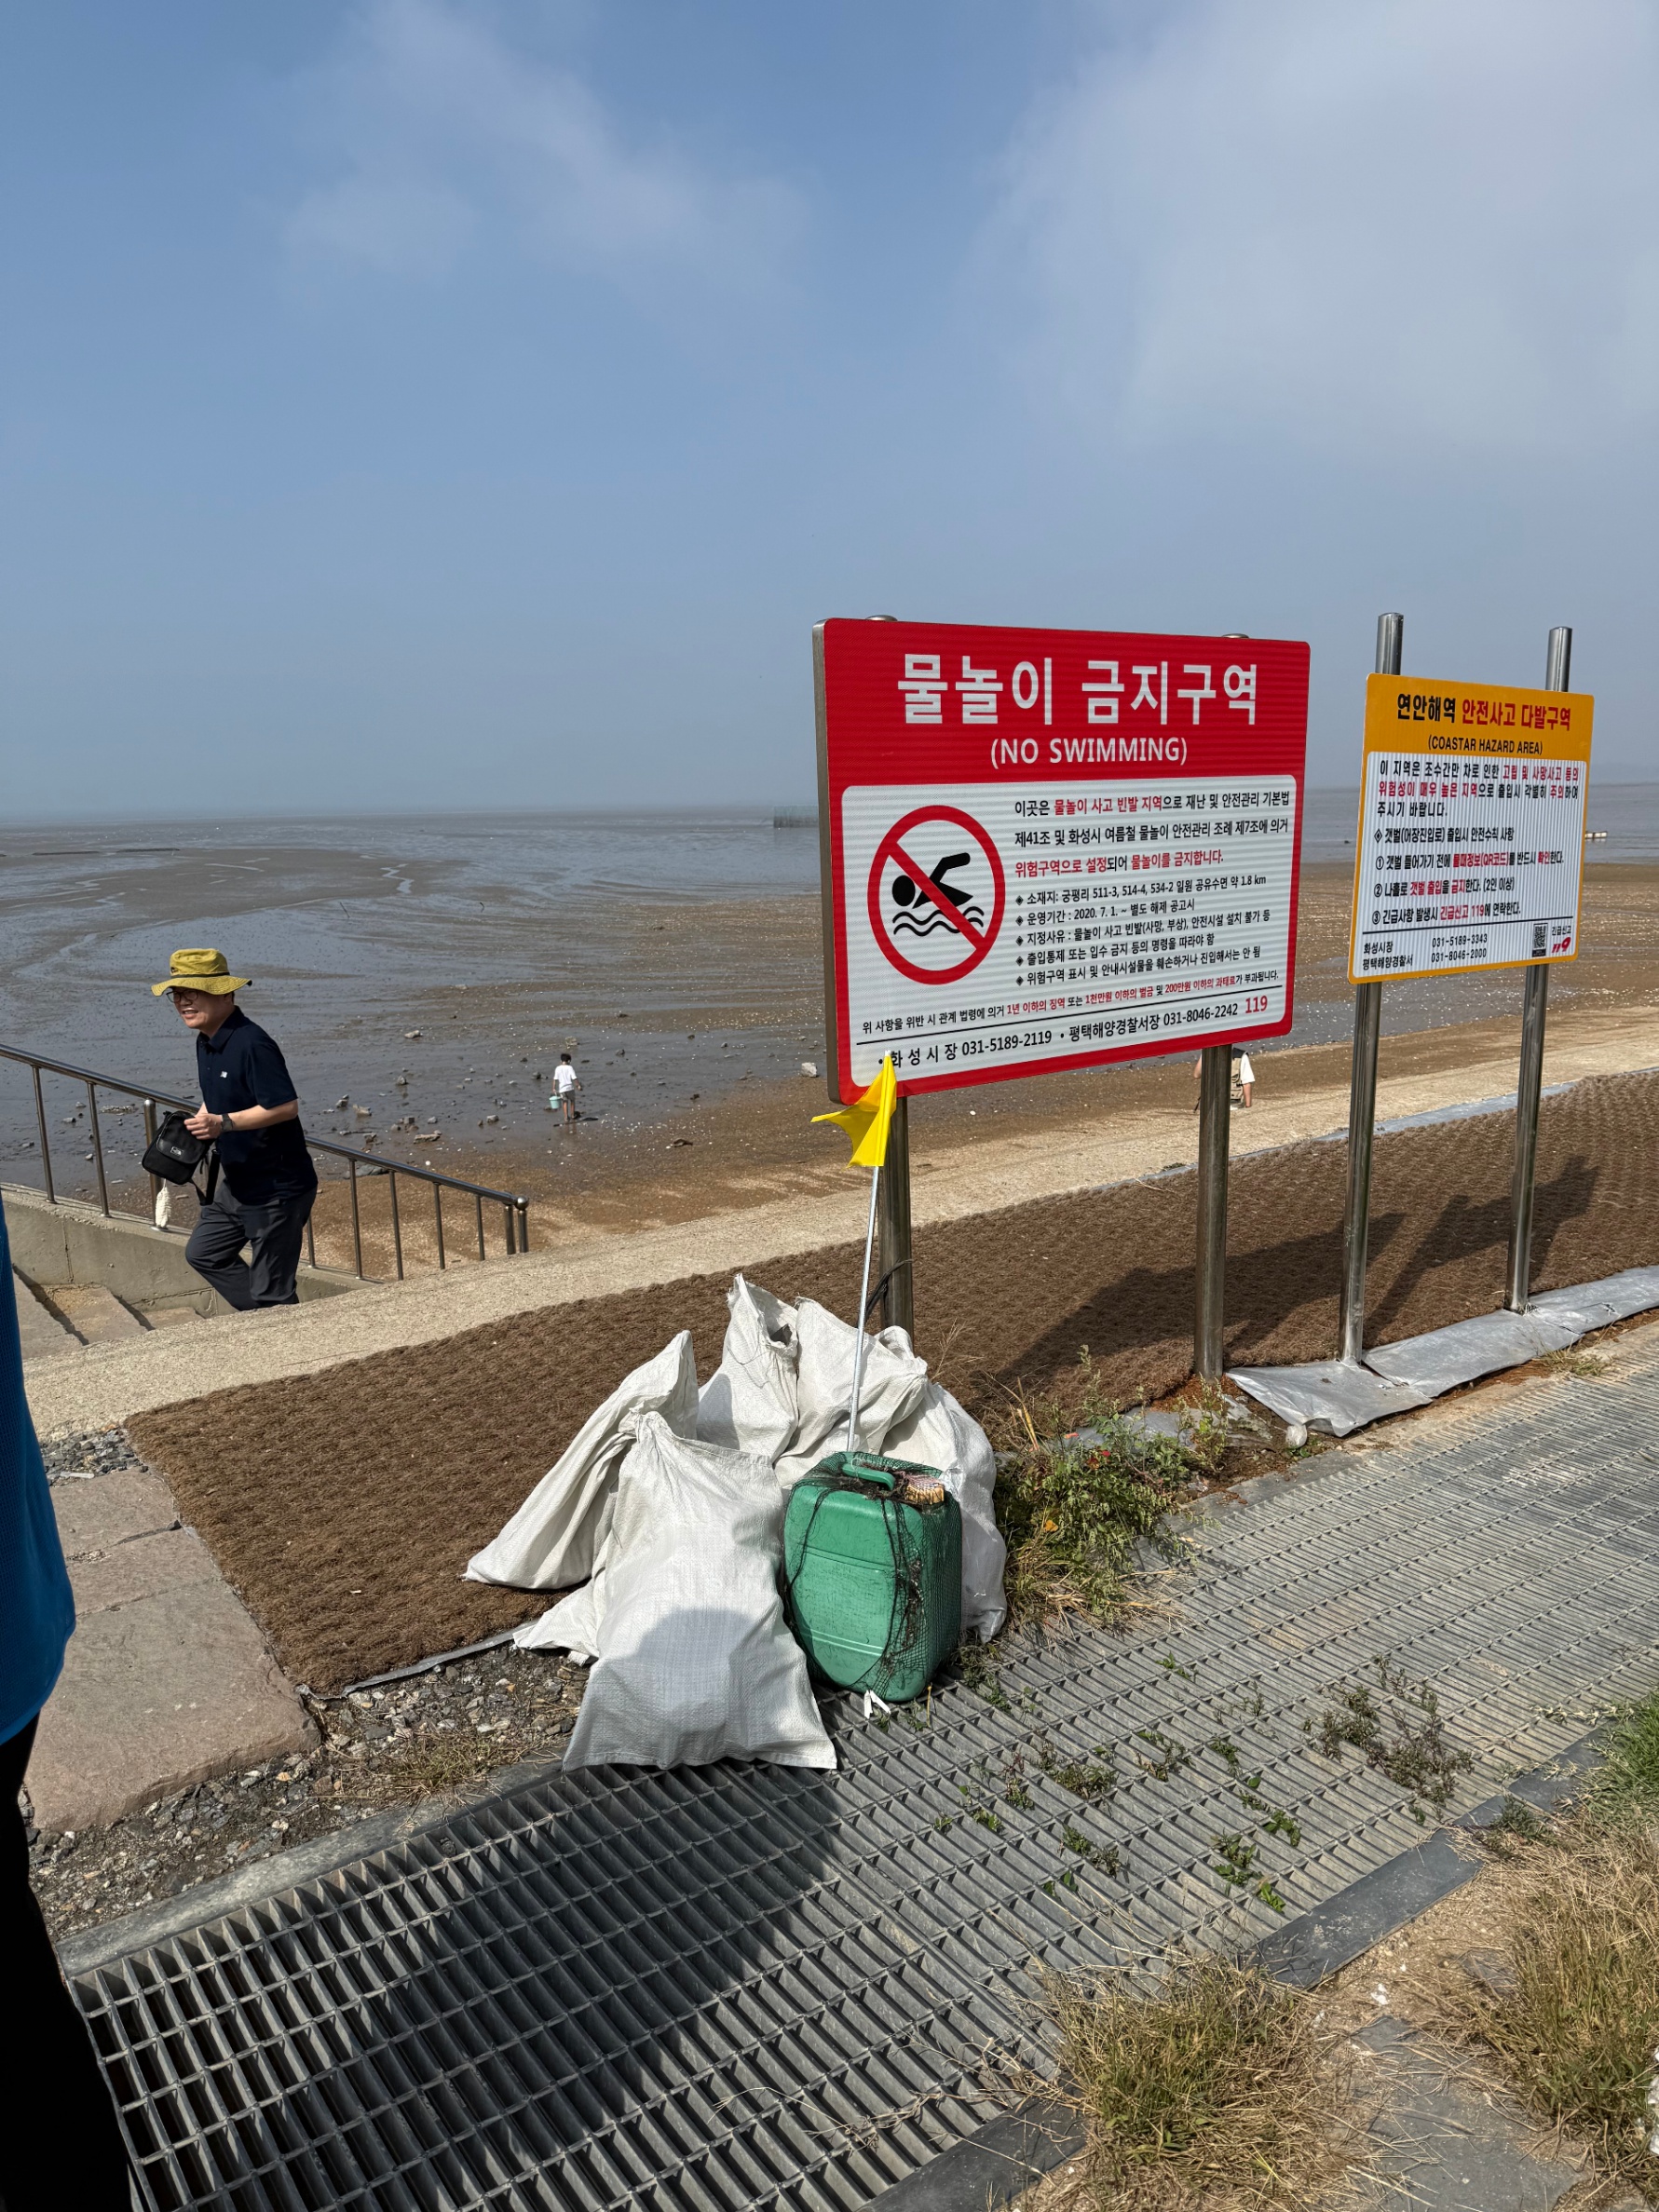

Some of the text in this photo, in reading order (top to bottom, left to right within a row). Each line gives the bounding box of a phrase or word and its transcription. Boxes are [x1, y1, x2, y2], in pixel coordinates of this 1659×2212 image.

[898, 654, 1257, 726] 물놀이 금지구역
[1397, 694, 1571, 730] 연안해역 안전사고 다발구역
[991, 737, 1187, 768] (NO SWIMMING)
[1428, 735, 1543, 754] (COASTAR HAZARD AREA)
[1380, 760, 1579, 781] 이 지역은 조수간만 차로 인한 고립 및 사망사고 등의
[1379, 781, 1578, 799] 위험성이 매우 높은 지역으로 출입시 각별히 주의하여
[1015, 791, 1289, 817] 이곳은 물놀이 사고 빈발 지역으로 재난 및 안전관리 기본법
[1378, 802, 1448, 817] 주시기 바랍니다.
[1015, 818, 1288, 848] 제41조 및 화성시 여름철 물놀이 안전관리 조례 제7조에 의거
[1448, 827, 1468, 843] 출입시
[1471, 827, 1498, 842] 안전수칙
[1501, 827, 1514, 841] 사항
[1015, 849, 1224, 878] 위험구역으로 설정되어 물놀이를 금지합니다.
[1386, 855, 1402, 870] 갯벌
[1405, 854, 1434, 869] 들어가기
[1436, 854, 1450, 868] 전에
[1517, 851, 1535, 865] 반드시
[1538, 851, 1564, 864] 확인한다.
[1027, 890, 1058, 905] 소재지:
[1062, 889, 1089, 902] 궁평리
[1093, 887, 1119, 899] 511-3,
[1122, 884, 1148, 896] 514-4,
[1150, 882, 1174, 893] 534-2
[1176, 880, 1192, 893] 일원
[1195, 877, 1228, 891] 공유수면
[1231, 875, 1238, 889] 약
[1255, 875, 1266, 885] km
[1385, 881, 1407, 897] 나홀로
[1410, 880, 1425, 895] 갯벌
[1427, 880, 1448, 894] 출입을
[1451, 878, 1481, 893] 금지한다.
[1483, 877, 1497, 892] (2인
[1499, 877, 1514, 891] 이상)
[1027, 910, 1066, 926] 운영기간
[1074, 908, 1096, 920] 2020.
[1101, 907, 1108, 916] 7.
[1110, 906, 1118, 916] 1.
[1131, 902, 1147, 916] 별도
[1150, 901, 1166, 914] 해제
[1170, 898, 1194, 912] 공고시
[1382, 908, 1414, 924] 긴급사항
[1416, 906, 1438, 922] 발생시
[1440, 904, 1468, 920] 긴급신고
[1472, 903, 1490, 917] 119에
[1493, 902, 1520, 916] 연락한다.
[1027, 930, 1064, 945] 지정사유
[1074, 927, 1100, 942] 물놀이
[1105, 925, 1122, 938] 사고
[1191, 914, 1223, 930] 안전시설
[1227, 912, 1241, 925] 설치
[1244, 911, 1259, 923] 불가
[1263, 909, 1270, 921] 등
[1552, 926, 1571, 936] 긴급신고
[1027, 933, 1215, 966] 출입통제 또는 입수 금지 등의 명령을 따라야 함
[1364, 941, 1393, 955] 화성시장
[1027, 946, 1260, 985] 위험구역 표시 및 안내시설물을 훼손하거나 진입해서는 안 됨
[1363, 955, 1413, 970] 평택해양경찰서
[863, 1022, 872, 1034] 위
[876, 1018, 903, 1033] 사항을
[906, 1015, 924, 1029] 위반
[939, 1011, 957, 1025] 관계
[959, 1008, 986, 1022] 법령에
[987, 1005, 1004, 1018] 의거
[1007, 1004, 1020, 1015] 1년
[1023, 999, 1047, 1013] 이하의
[1050, 997, 1065, 1011] 징역
[1067, 996, 1082, 1007] 또는
[1086, 991, 1112, 1004] 1천만원
[1115, 988, 1136, 1001] 이하의
[1140, 985, 1153, 997] 벌금
[1156, 984, 1163, 995] 및
[1165, 980, 1190, 993] 200만원
[1193, 977, 1214, 990] 이하의
[1216, 973, 1243, 987] 과태료가
[1244, 970, 1278, 984] 부과됩니다.
[962, 1031, 1052, 1056] 031-5189-2119
[1069, 1014, 1160, 1041] 평택해양경찰서장
[1163, 1003, 1238, 1025] 031-8046-2242
[1245, 996, 1268, 1013] 119
